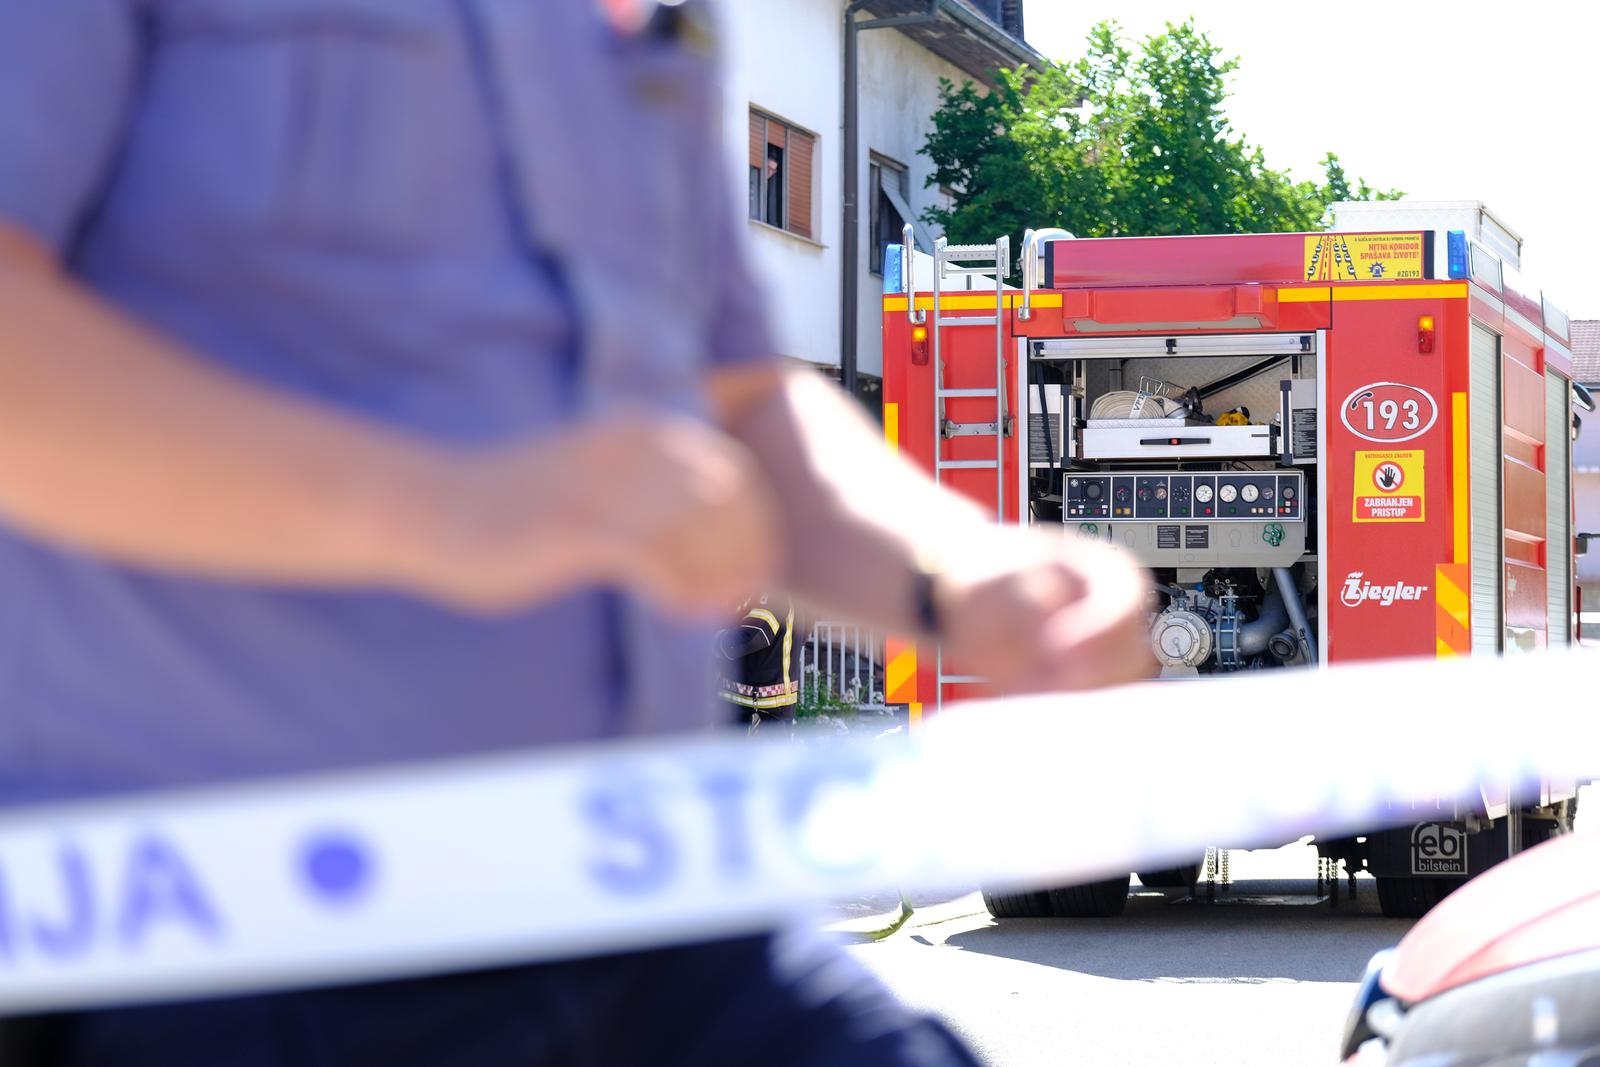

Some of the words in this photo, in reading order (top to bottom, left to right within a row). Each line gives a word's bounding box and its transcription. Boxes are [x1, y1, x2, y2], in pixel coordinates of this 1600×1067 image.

[1363, 399, 1420, 430] 193
[1364, 497, 1413, 507] ZABRANJEN
[1371, 507, 1407, 517] PRISTUP
[1340, 571, 1428, 607] Ziegler
[1418, 859, 1461, 872] bilstein
